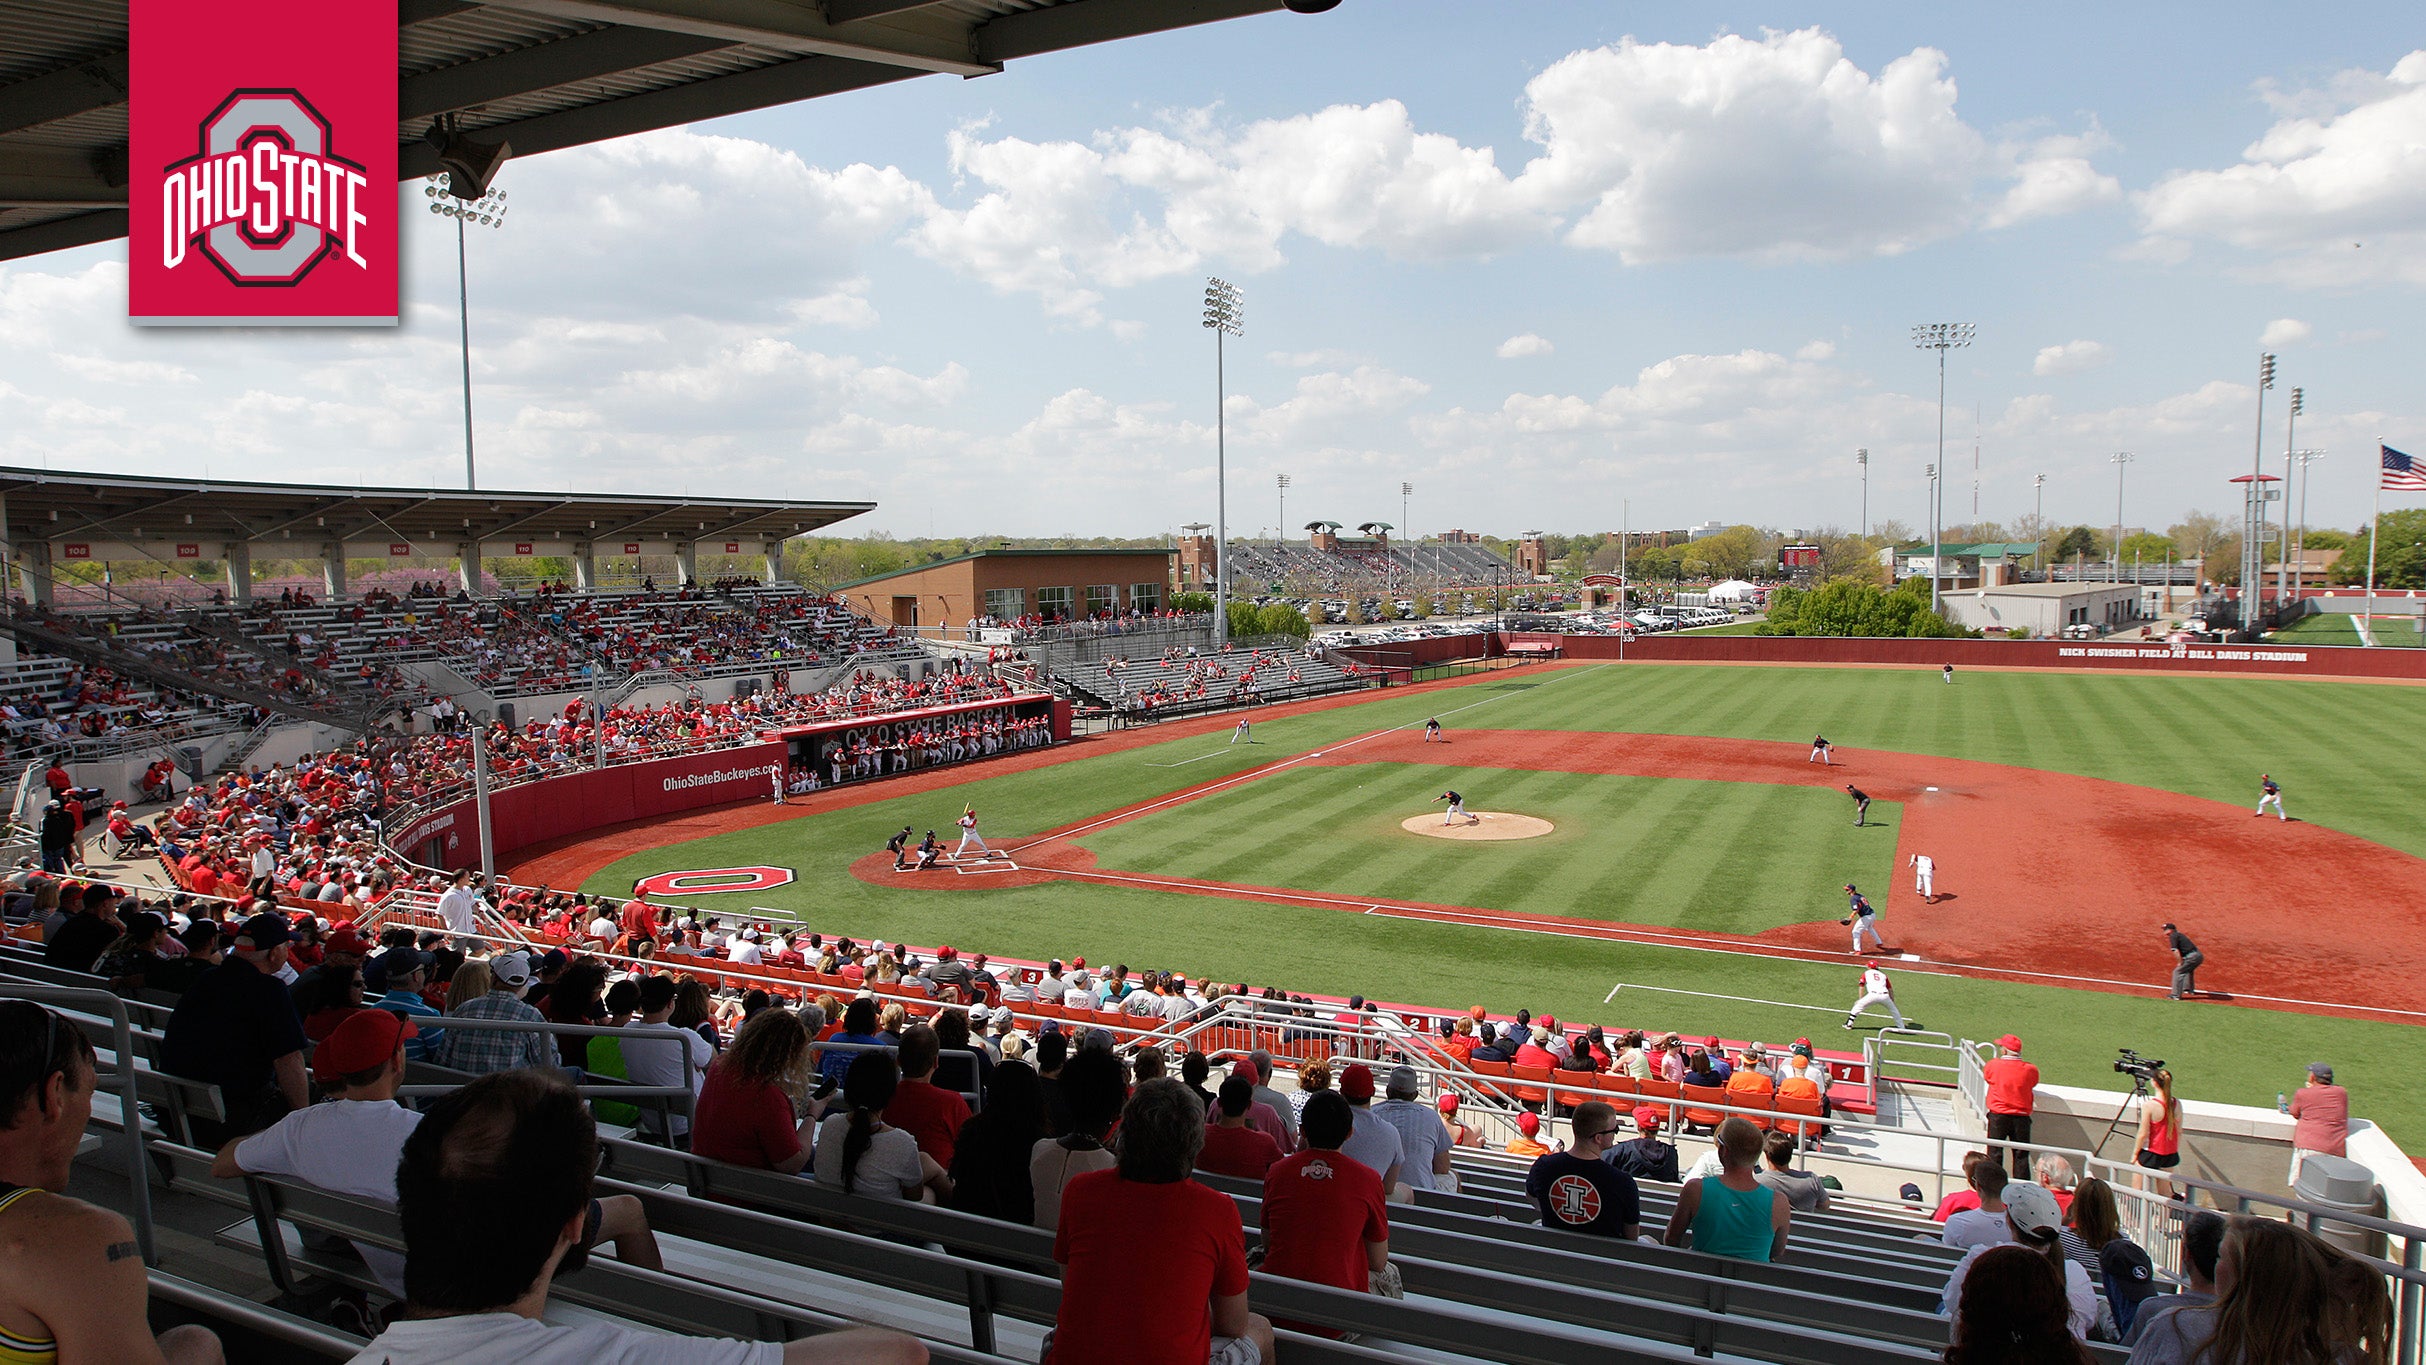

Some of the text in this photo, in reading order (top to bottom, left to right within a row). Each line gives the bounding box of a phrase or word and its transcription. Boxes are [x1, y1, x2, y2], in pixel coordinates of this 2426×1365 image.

[180, 547, 196, 555] 109
[2059, 648, 2307, 662] NICK SWISHER FIELD AT BILL DAVIS STADIUM
[1027, 973, 1037, 983] 3
[1410, 1018, 1420, 1030] 2
[1841, 1067, 1851, 1080] 1
